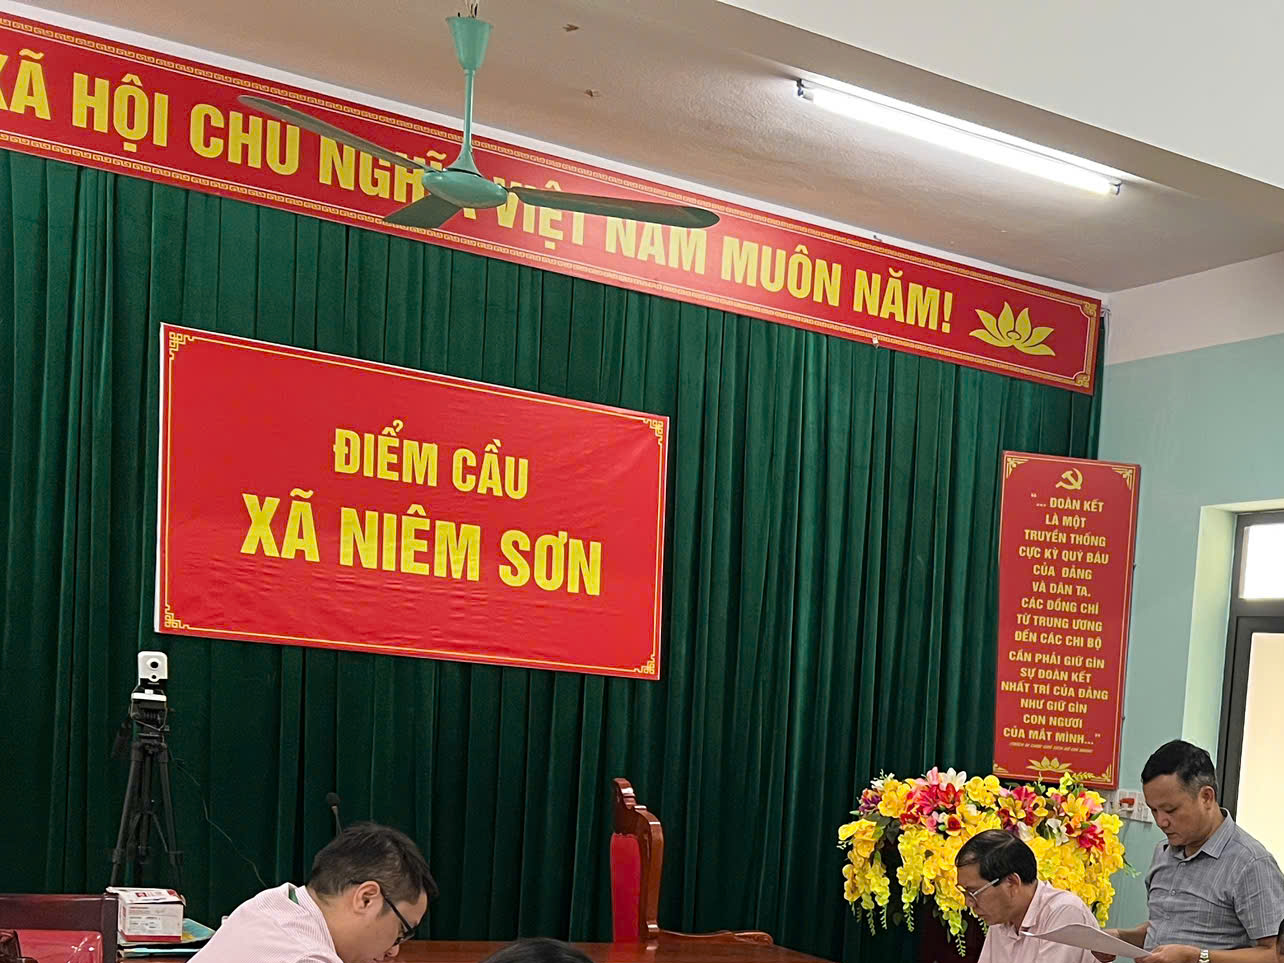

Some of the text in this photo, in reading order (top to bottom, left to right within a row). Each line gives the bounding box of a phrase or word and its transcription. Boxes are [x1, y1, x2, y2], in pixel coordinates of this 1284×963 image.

[72, 72, 169, 152] HỘI
[606, 215, 707, 275] NAM
[721, 237, 843, 307] MUÔN
[853, 267, 953, 333] NĂM!
[333, 419, 529, 500] ĐIỂM CẦU
[1045, 512, 1086, 529] LÀ MỘT
[240, 488, 602, 596] XÃ NIÊM SƠN
[1033, 562, 1055, 576] CỦA
[1032, 580, 1046, 593] VÀ
[1033, 616, 1069, 628] TRUNG
[1040, 631, 1063, 645] CÁC
[1066, 635, 1083, 647] CHI
[1087, 637, 1102, 651] BỘ
[1020, 667, 1036, 680] SỰ
[1053, 684, 1075, 697] CỦA
[1020, 698, 1044, 710] NHƯ
[1023, 714, 1046, 726] CON
[1003, 725, 1025, 739] CỦA
